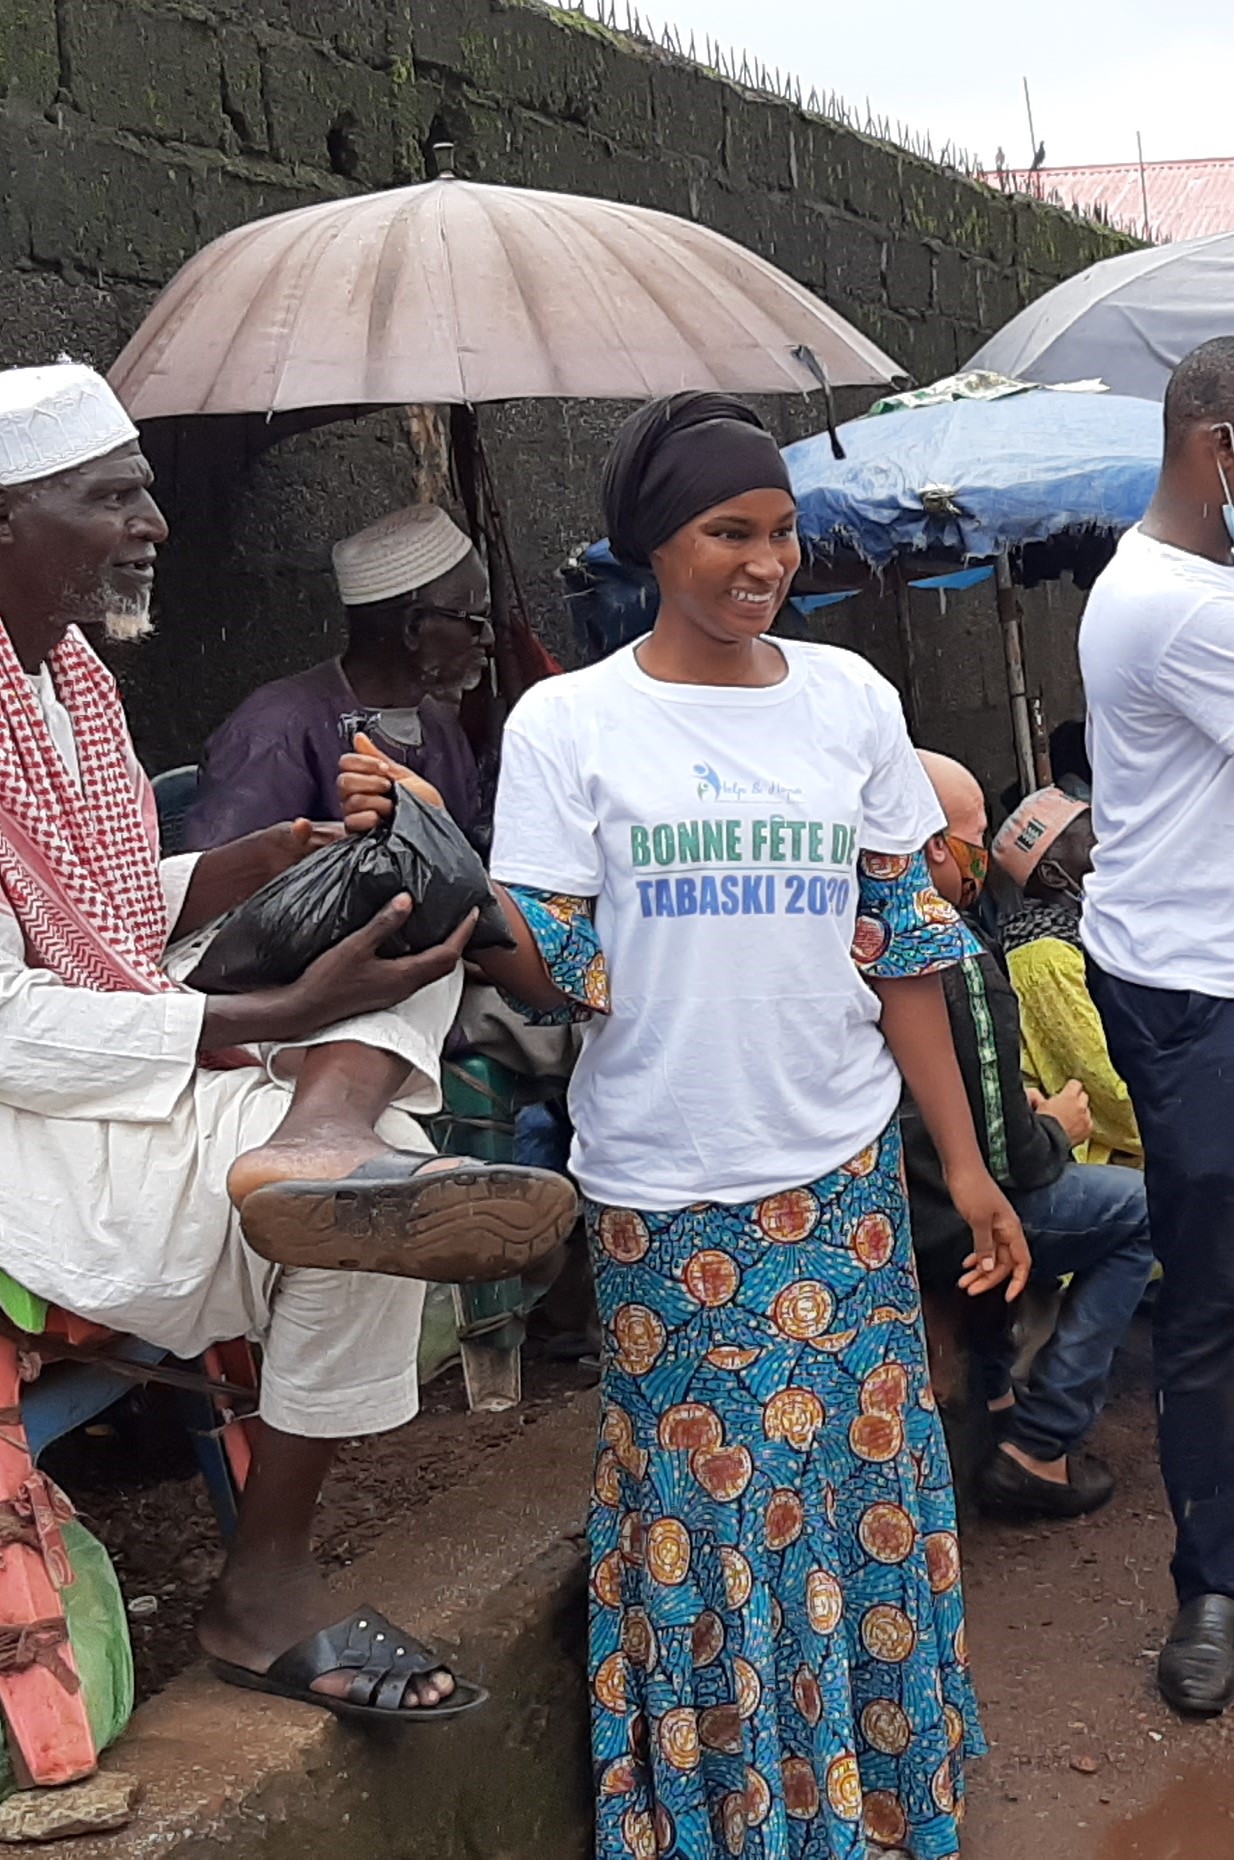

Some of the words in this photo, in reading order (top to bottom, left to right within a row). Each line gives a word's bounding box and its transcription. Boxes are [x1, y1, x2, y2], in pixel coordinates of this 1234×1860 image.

[630, 819, 742, 867] BONNE
[752, 814, 824, 863] FÊTE
[636, 875, 775, 918] TABASKI
